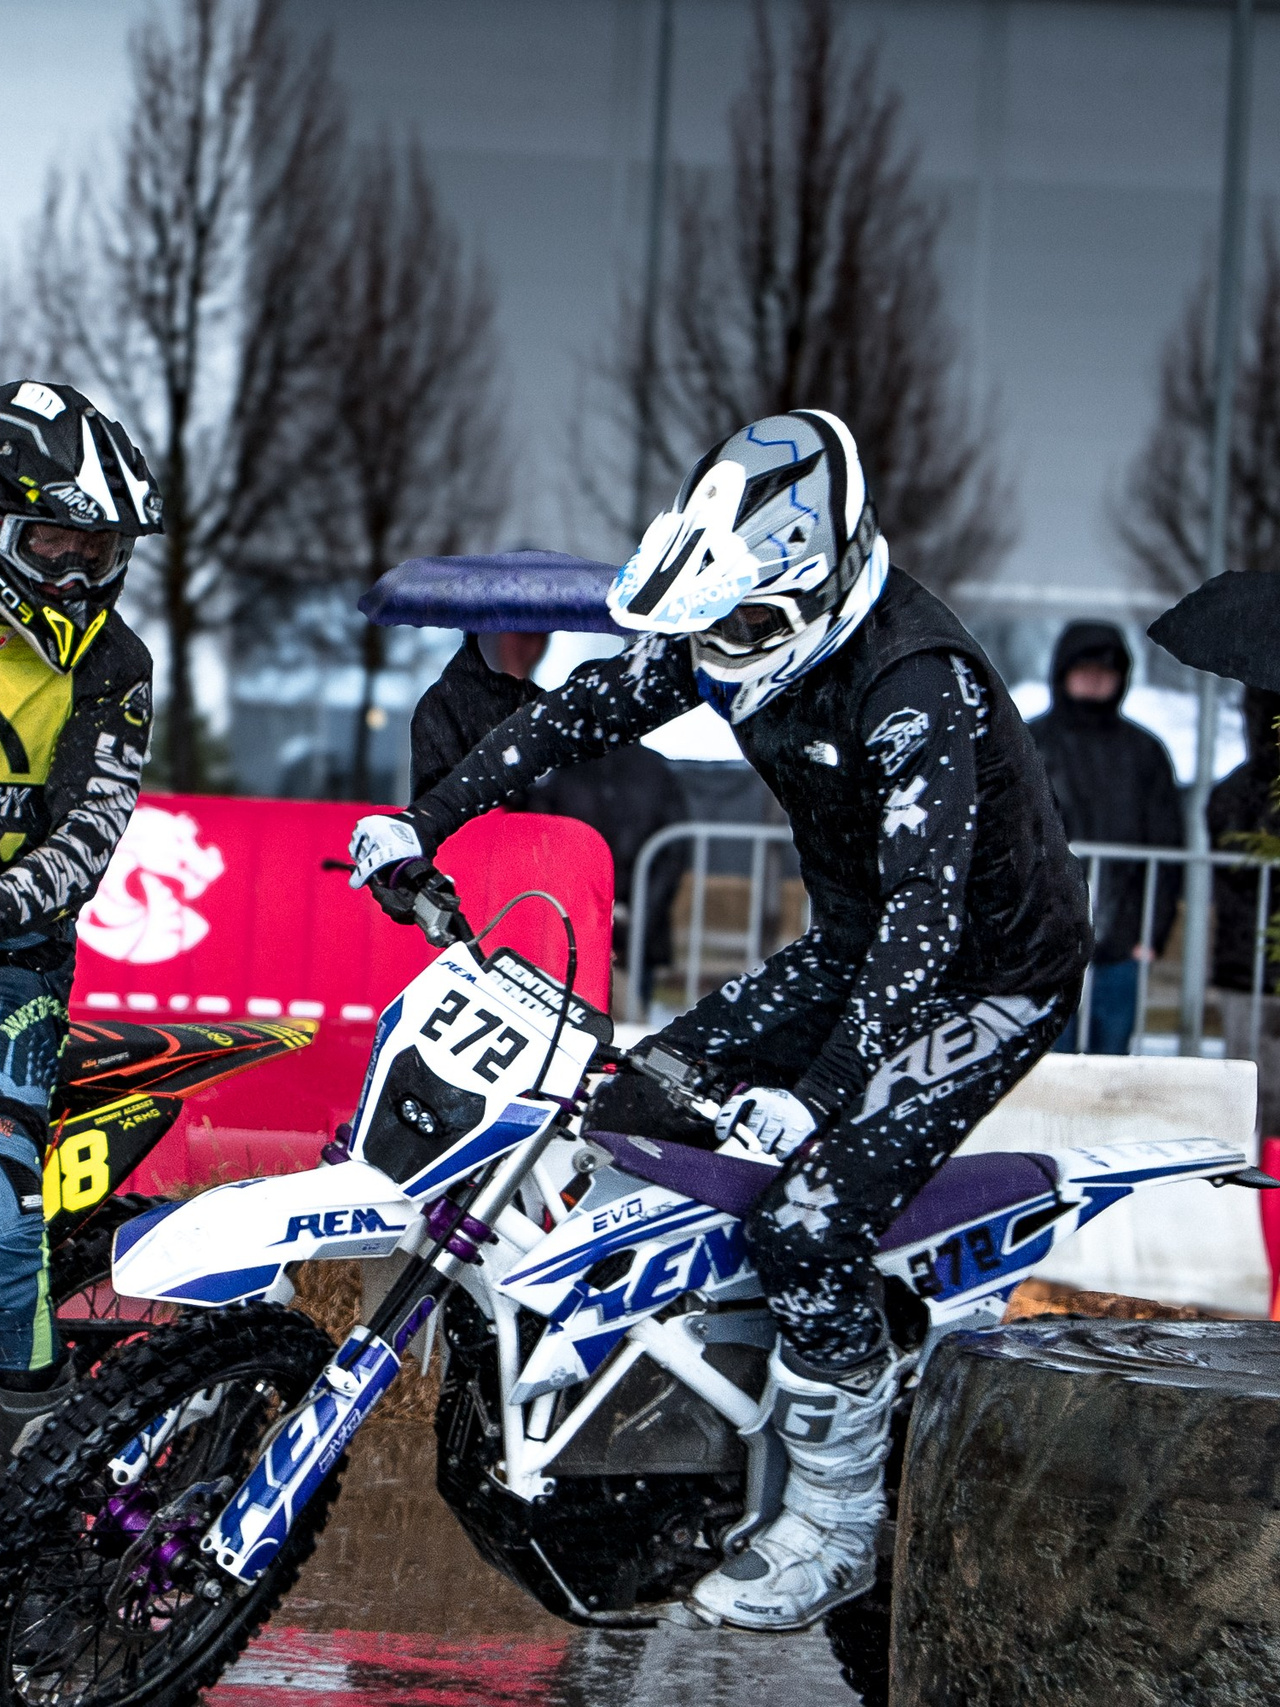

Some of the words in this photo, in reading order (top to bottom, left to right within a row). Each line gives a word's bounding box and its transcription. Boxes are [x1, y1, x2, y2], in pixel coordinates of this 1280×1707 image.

[419, 989, 530, 1084] 272
[592, 1197, 644, 1233] EVO
[908, 1228, 1002, 1297] 272
